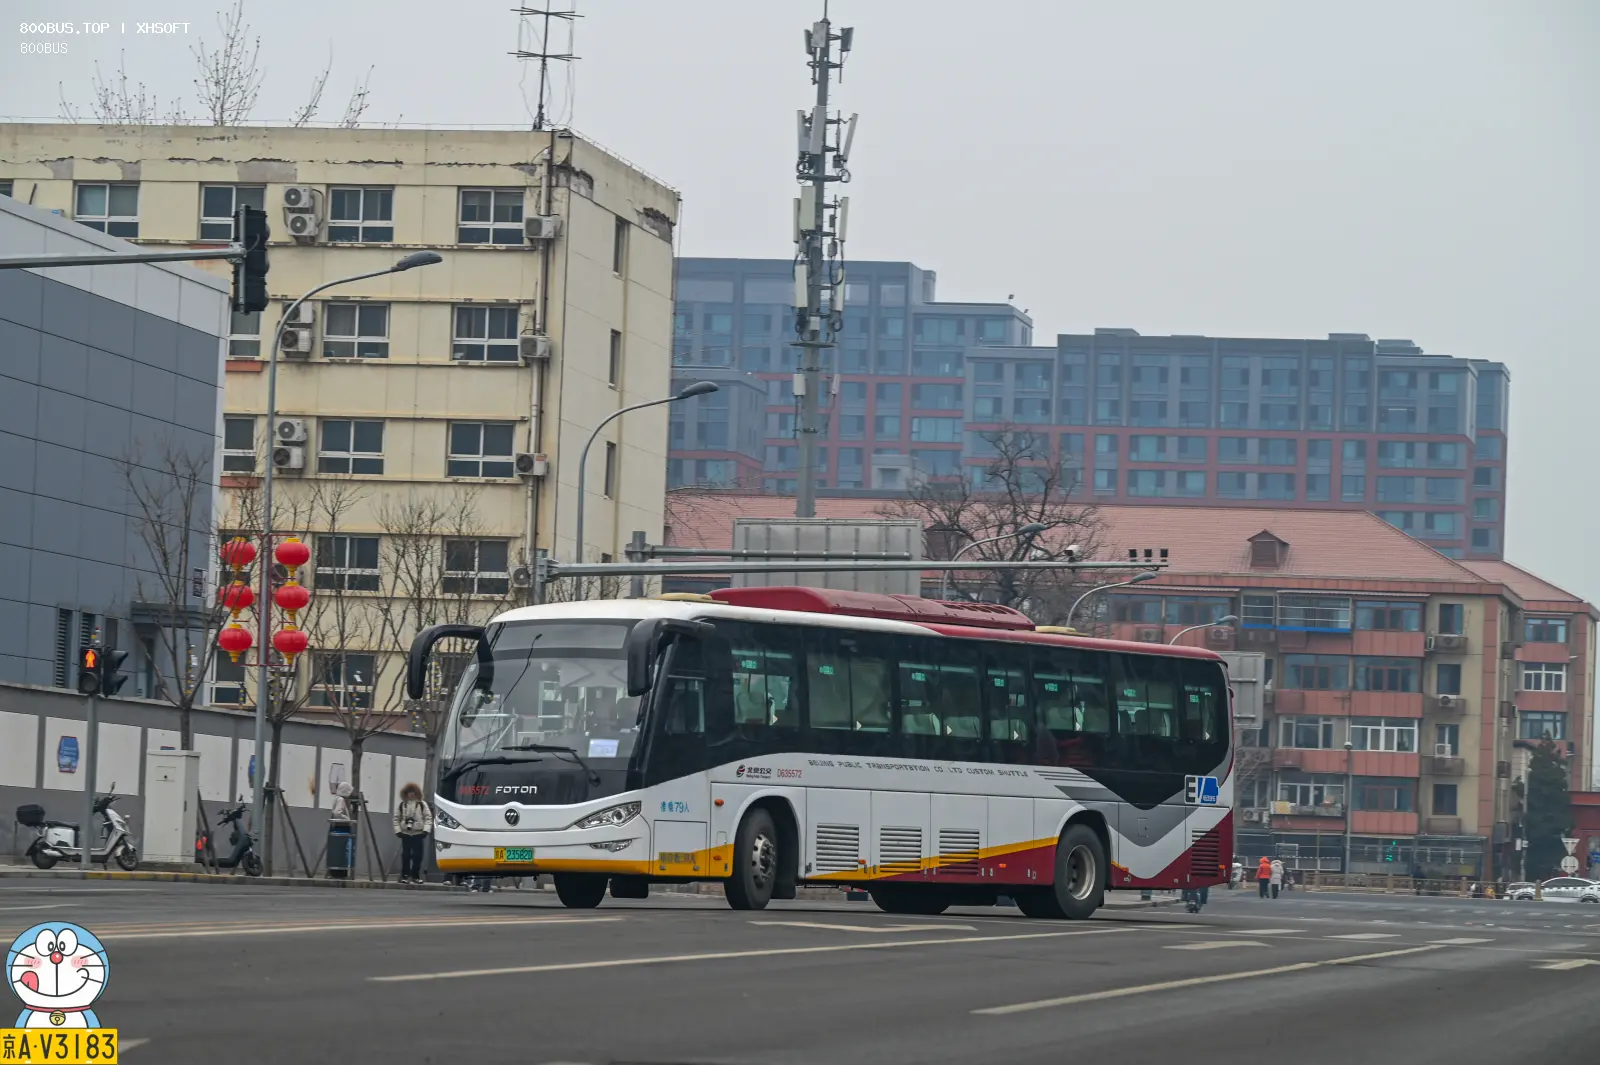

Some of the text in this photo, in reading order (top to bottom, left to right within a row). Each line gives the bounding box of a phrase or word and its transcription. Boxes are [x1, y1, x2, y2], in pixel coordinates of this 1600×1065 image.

[777, 769, 802, 778] D635572
[808, 759, 834, 767] BEIJING
[837, 761, 862, 769] PUBLIC
[865, 762, 930, 772] TRANSPORTATION
[966, 767, 995, 776] CUSTOM
[997, 769, 1029, 778] SHUTTLE
[458, 785, 489, 795] 5572
[495, 785, 538, 795] FOTON
